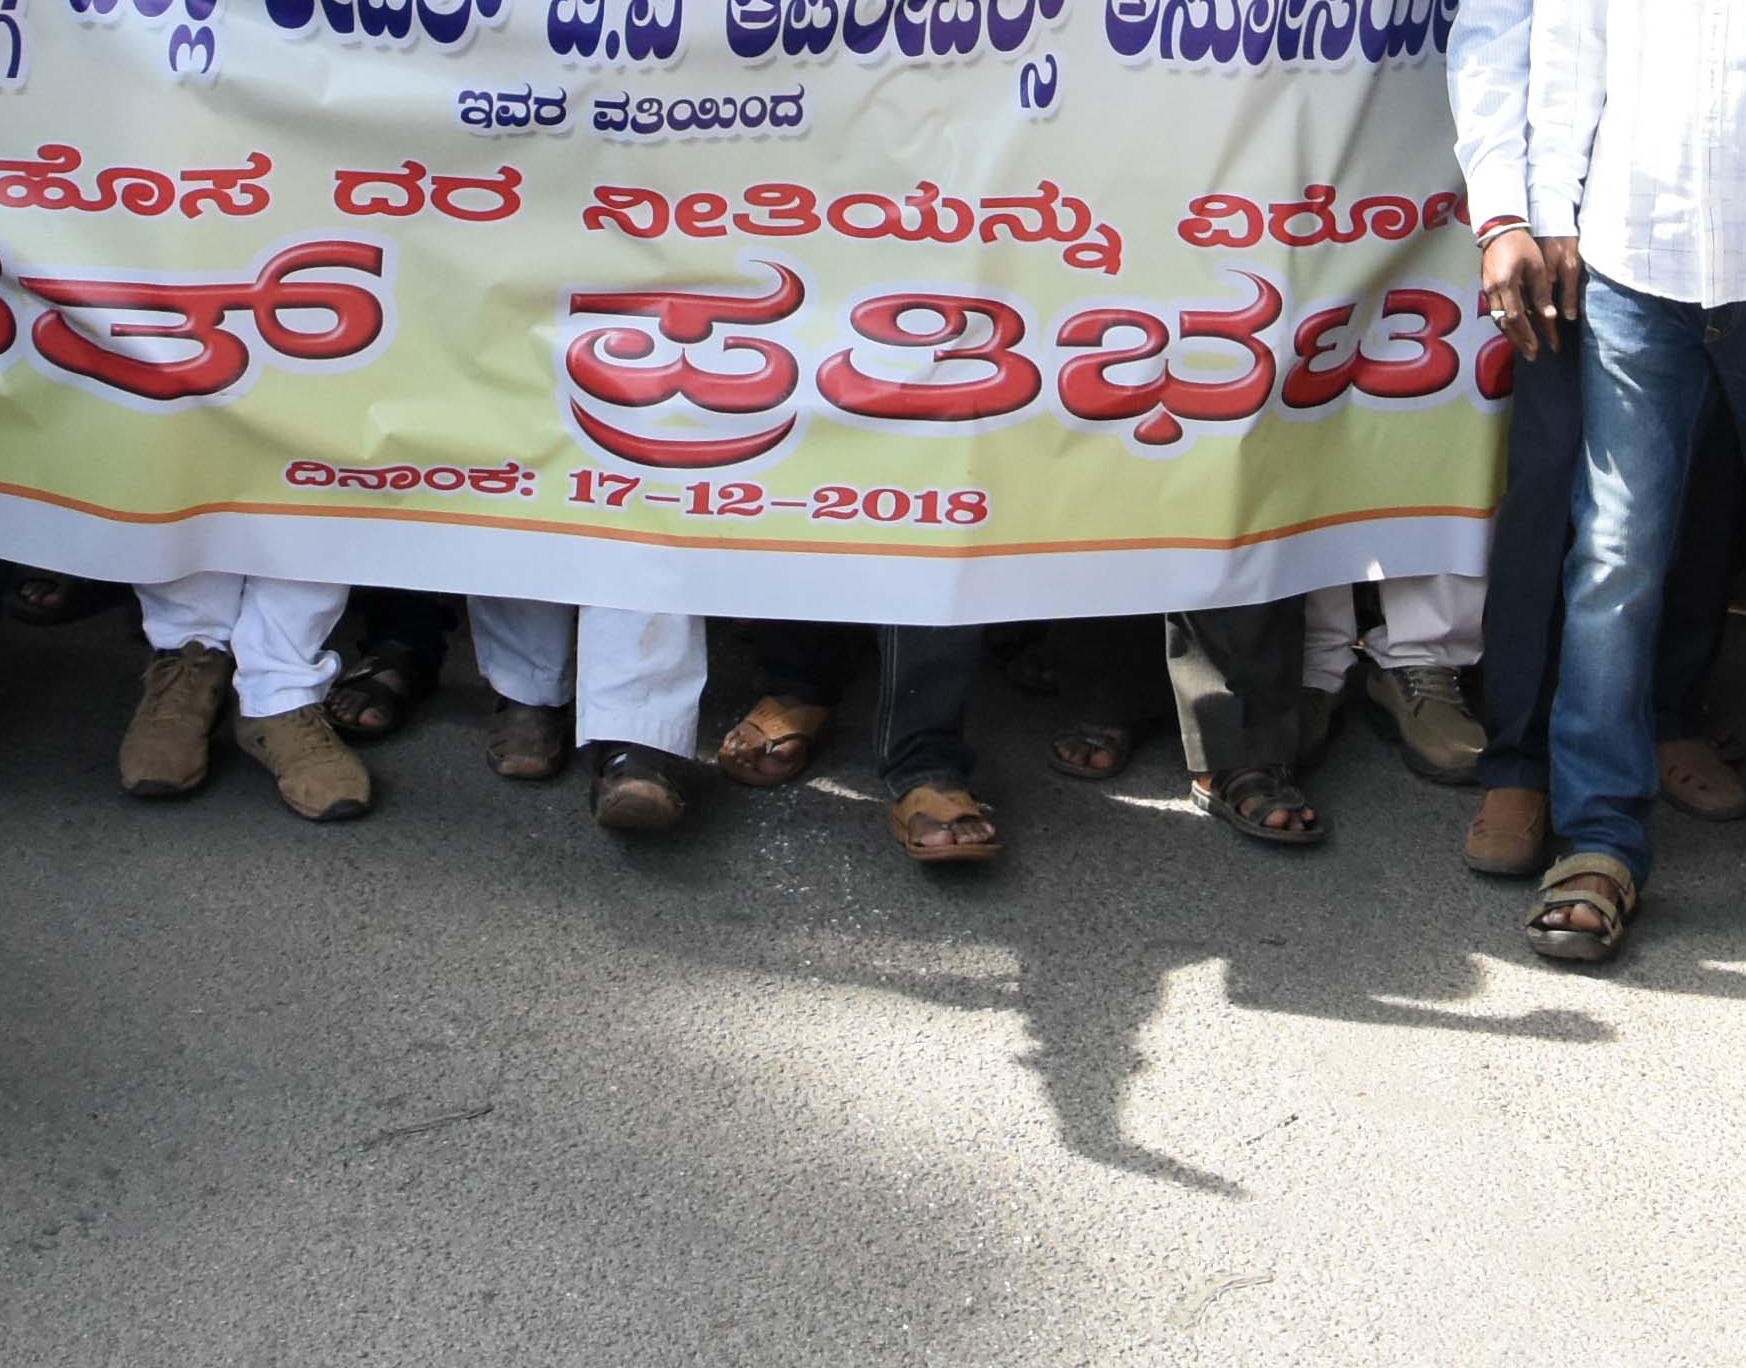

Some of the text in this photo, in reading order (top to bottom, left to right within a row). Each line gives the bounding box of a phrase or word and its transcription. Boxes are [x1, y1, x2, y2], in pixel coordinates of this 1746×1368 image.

[457, 83, 805, 134] ಇವರ ವತಿಯಿಂದ
[334, 160, 522, 221] ದರ
[582, 180, 1121, 276] ನೀತಿಯನ್ನು
[1178, 184, 1469, 248] ವಿರೋ
[285, 460, 989, 525] ದಿನಾಂಕ: 17-12-2018
